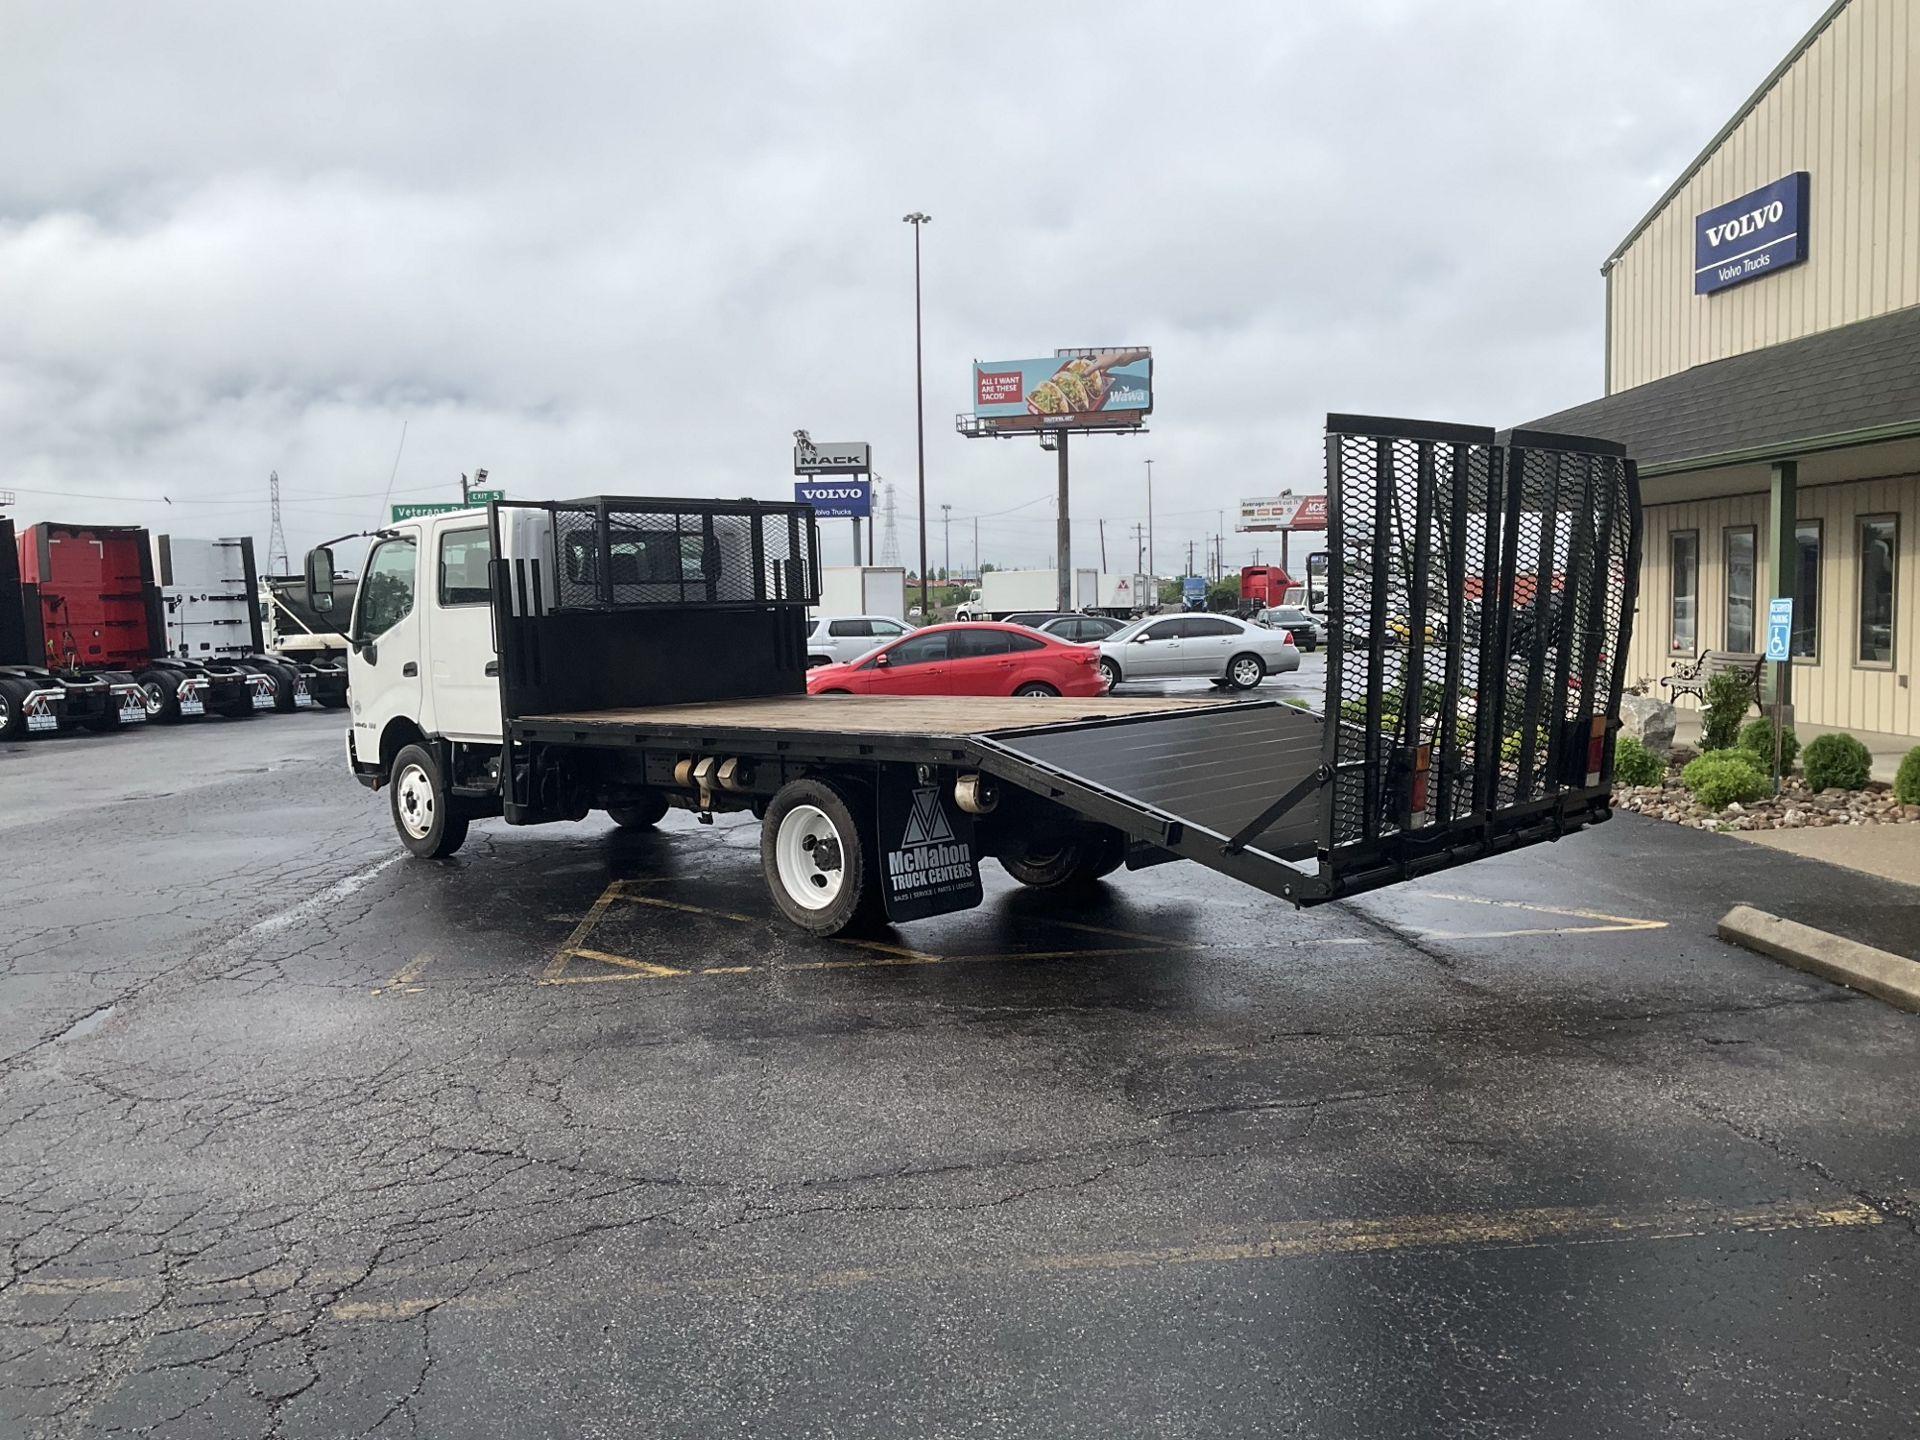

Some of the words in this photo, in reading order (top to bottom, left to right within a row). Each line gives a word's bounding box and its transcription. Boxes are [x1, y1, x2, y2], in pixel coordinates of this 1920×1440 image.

[1705, 200, 1784, 247] VOLVO
[1718, 264, 1742, 281] Volvo
[1743, 253, 1770, 272] Trucks
[999, 376, 1020, 384] WANT
[996, 384, 1017, 392] THESE
[1110, 390, 1145, 402] Wawa
[800, 456, 861, 465] MACK
[493, 492, 500, 500] 5
[802, 488, 862, 499] VOLVO
[832, 508, 852, 516] Trucks
[1305, 502, 1326, 512] ACE
[888, 843, 971, 876] McMahon
[890, 871, 930, 891] TRUCK
[928, 863, 973, 884] CENTERS
